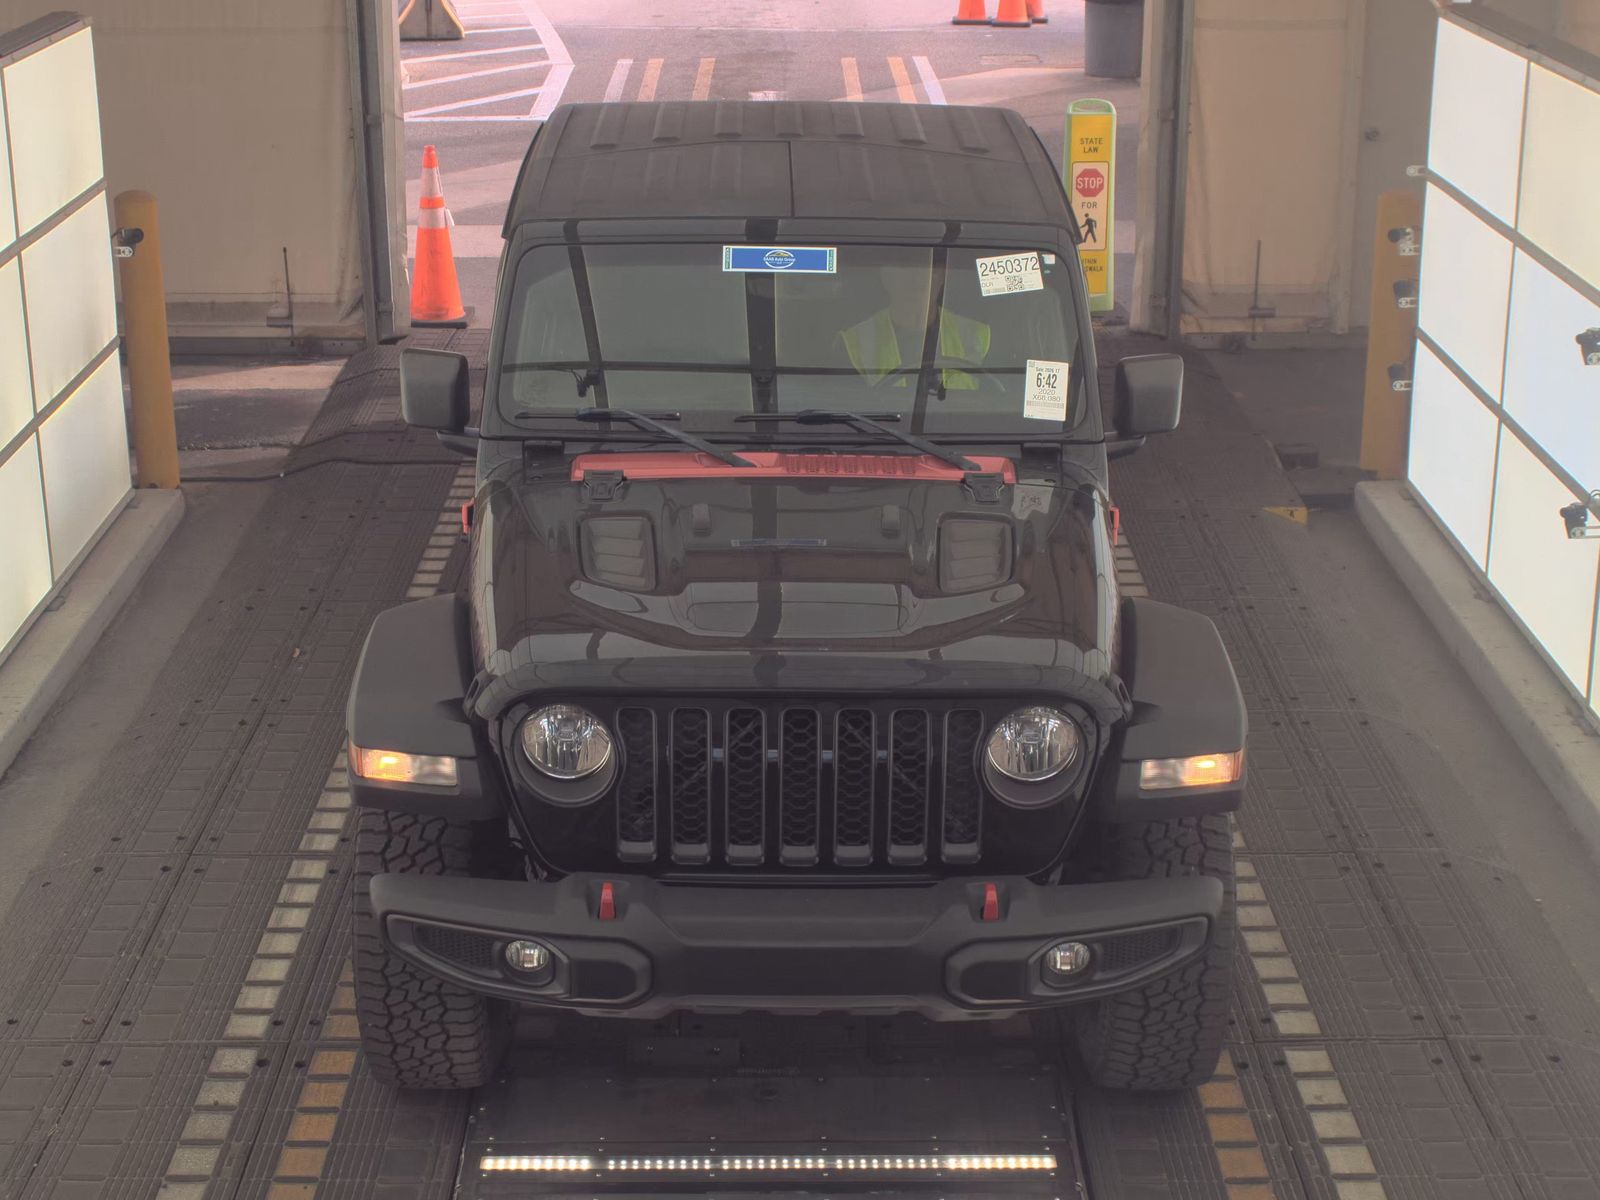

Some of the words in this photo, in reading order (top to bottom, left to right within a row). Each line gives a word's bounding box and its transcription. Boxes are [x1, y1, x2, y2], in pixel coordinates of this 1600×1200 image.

[1076, 177, 1103, 190] STOP
[980, 256, 1040, 277] 2450372
[1036, 372, 1057, 388] 6:42
